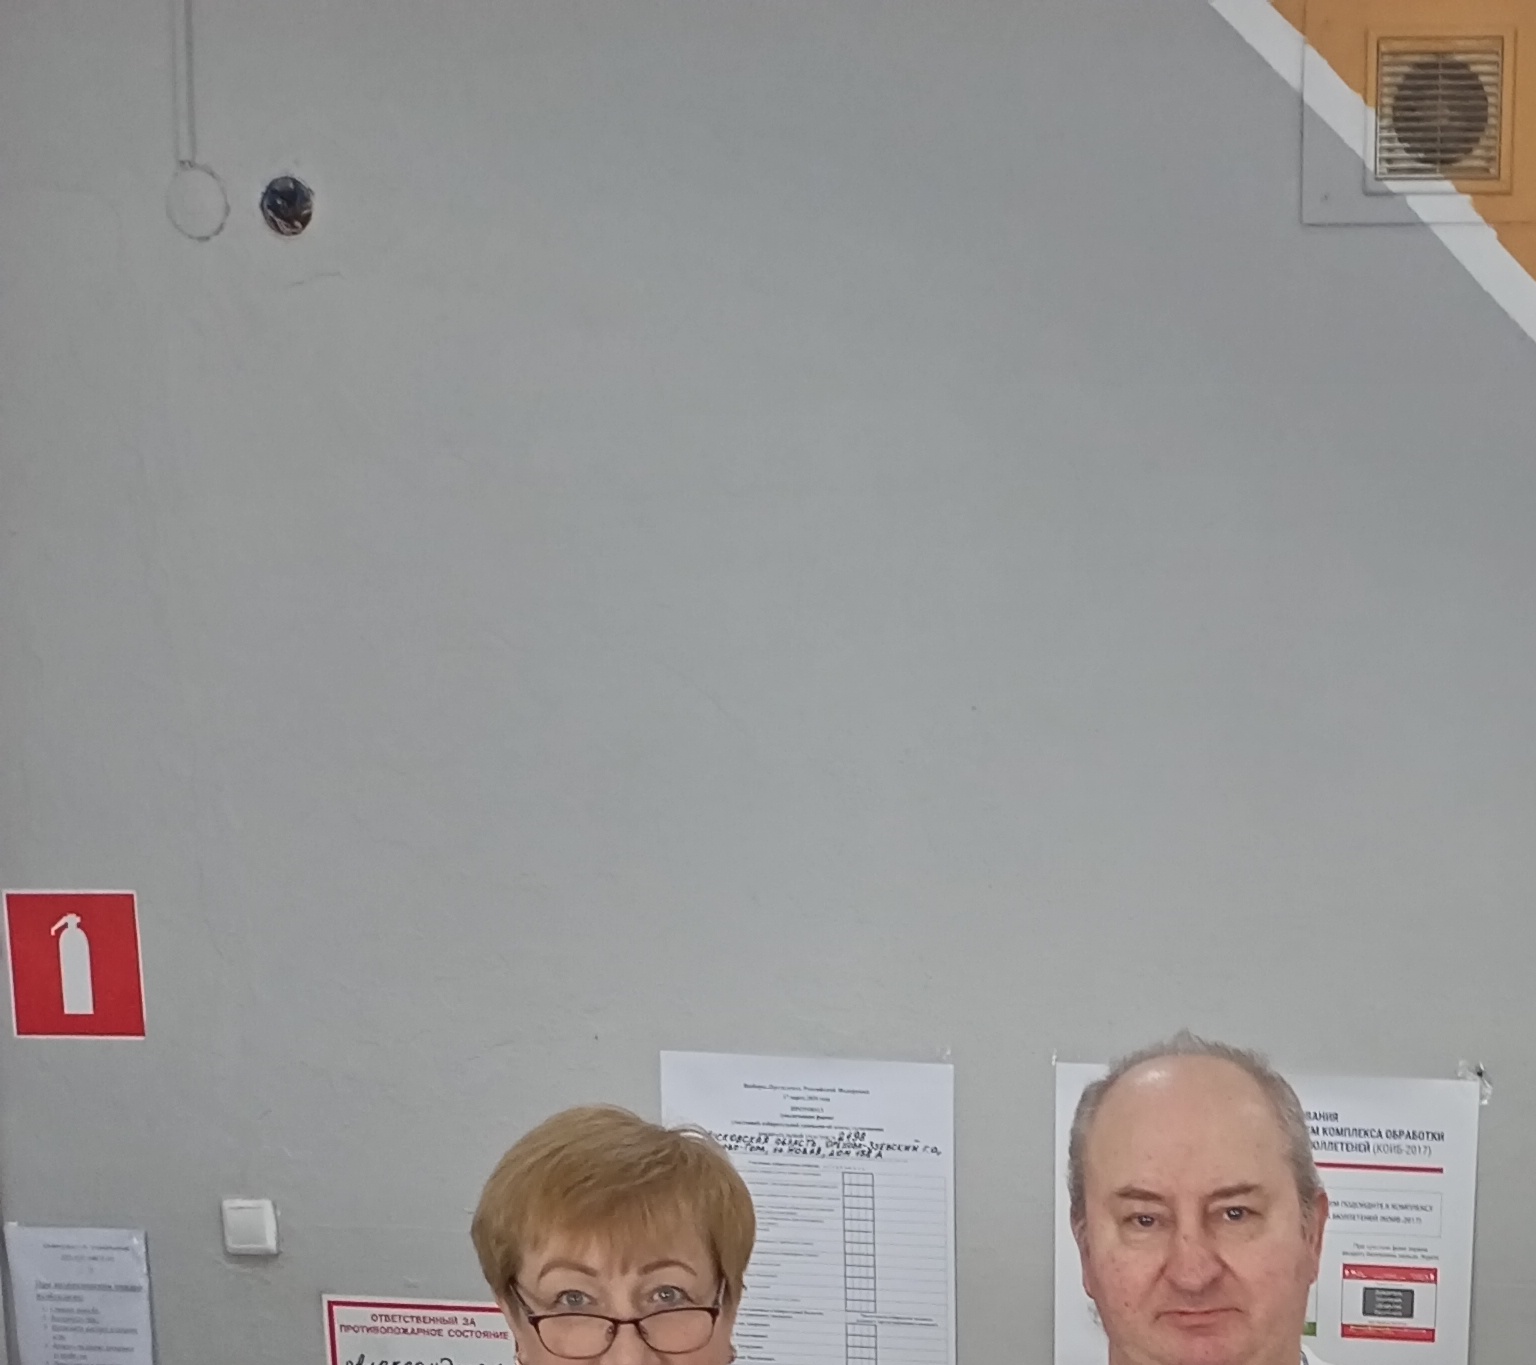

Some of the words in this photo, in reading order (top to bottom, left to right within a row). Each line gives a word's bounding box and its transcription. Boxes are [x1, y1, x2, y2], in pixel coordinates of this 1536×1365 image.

[1322, 1127, 1383, 1139] КОМПЛЕКСА
[1385, 1130, 1445, 1142] ОБРАБОТКИ
[371, 1313, 459, 1326] ОТВЕТСТВЕННЫЙ
[462, 1316, 476, 1327] ЗА
[339, 1324, 444, 1338] ПРОТИВОПОЖАРНОЕ
[448, 1329, 510, 1340] СОСТОЯНИЕ
